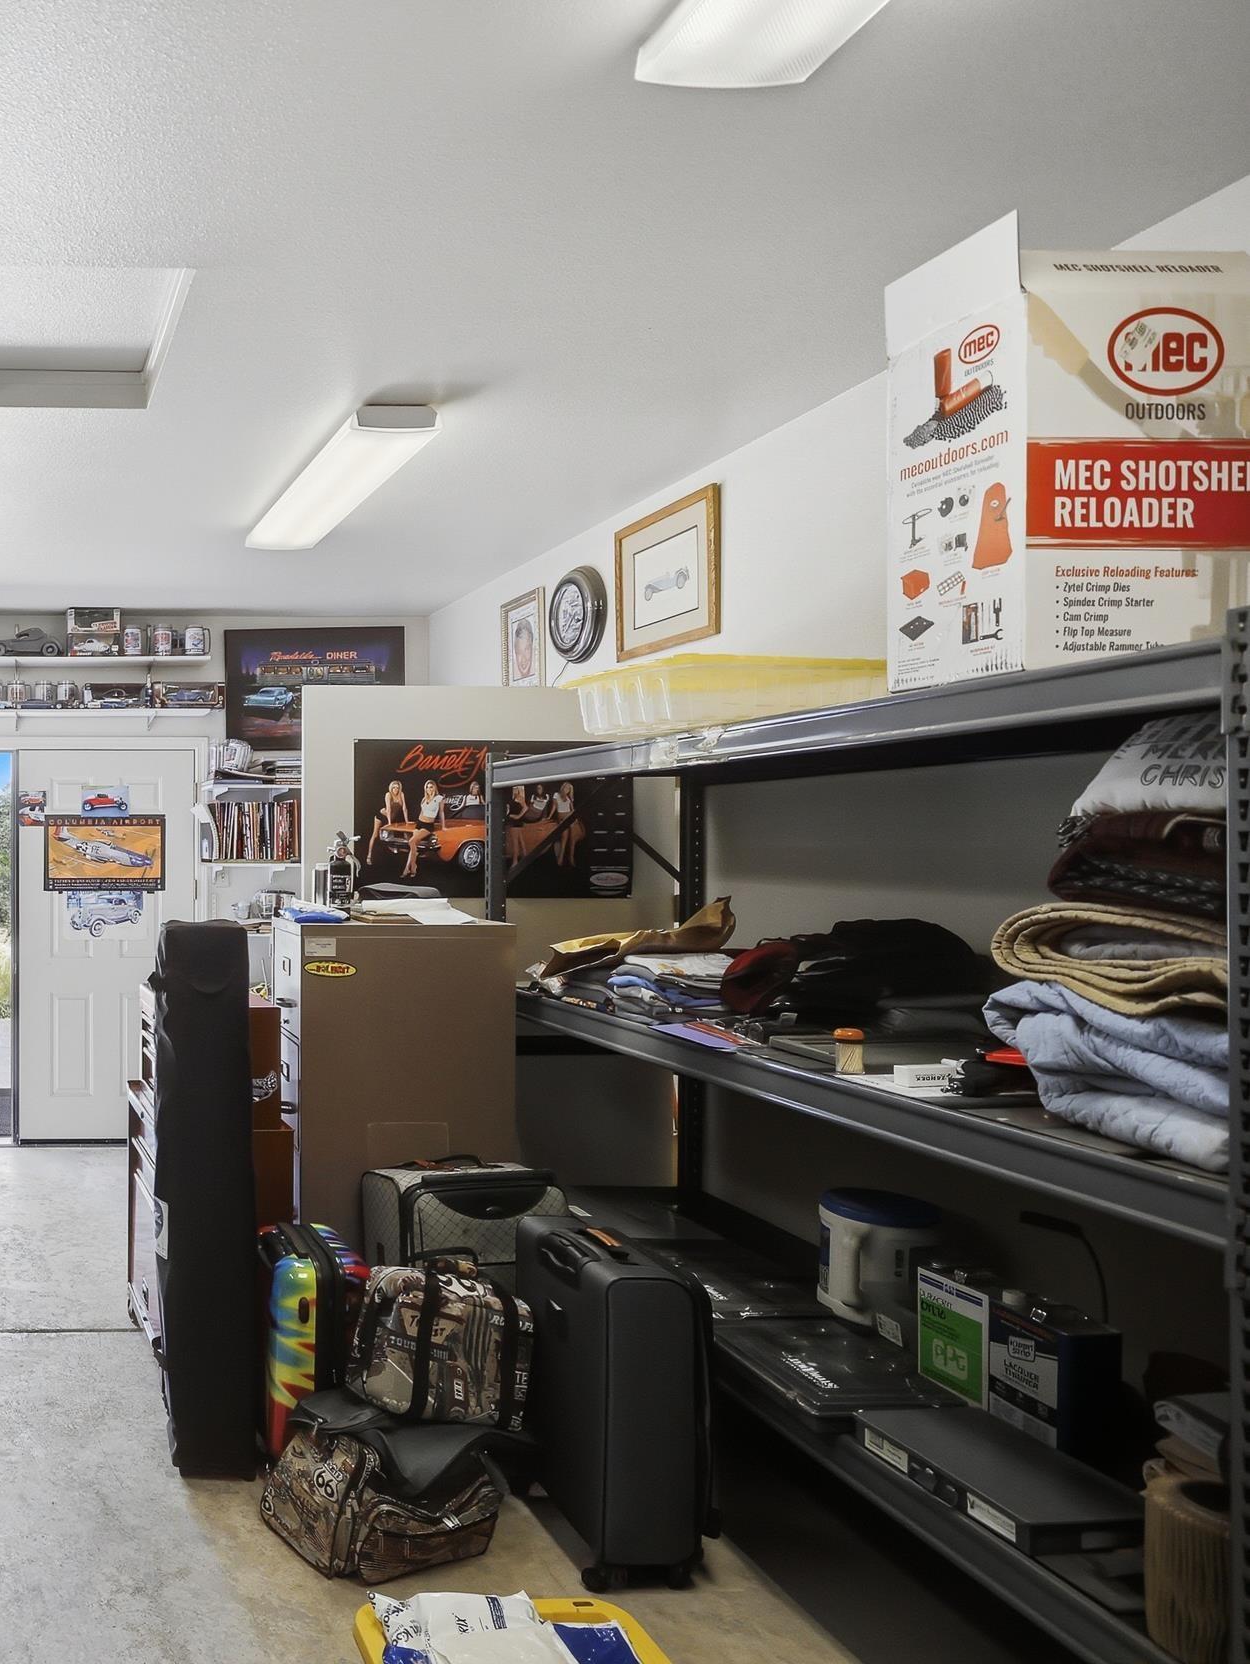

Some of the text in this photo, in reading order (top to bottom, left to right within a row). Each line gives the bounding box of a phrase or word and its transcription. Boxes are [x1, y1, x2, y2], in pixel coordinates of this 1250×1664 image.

[1054, 263, 1225, 273] MEC SHOTSHELL RELOADER
[1125, 402, 1206, 420] OUTDOORS
[900, 430, 1009, 481] mecoutdoors.com
[1054, 458, 1111, 491] MEC
[1054, 497, 1195, 529] RELOADER
[1055, 566, 1199, 580] Exclusive Reloading Features:
[1063, 582, 1131, 594] Zytel Crimp Dies
[1063, 597, 1154, 608] Spindex Crimp Starter
[1063, 611, 1109, 623] Cam Crimp
[1063, 626, 1132, 638] Flip Top Measure
[1063, 641, 1107, 653] Adjustable
[1109, 641, 1143, 651] Rammer
[326, 651, 358, 660] DINER
[1003, 1359, 1040, 1382] LACQUER
[315, 1470, 335, 1499] 66
